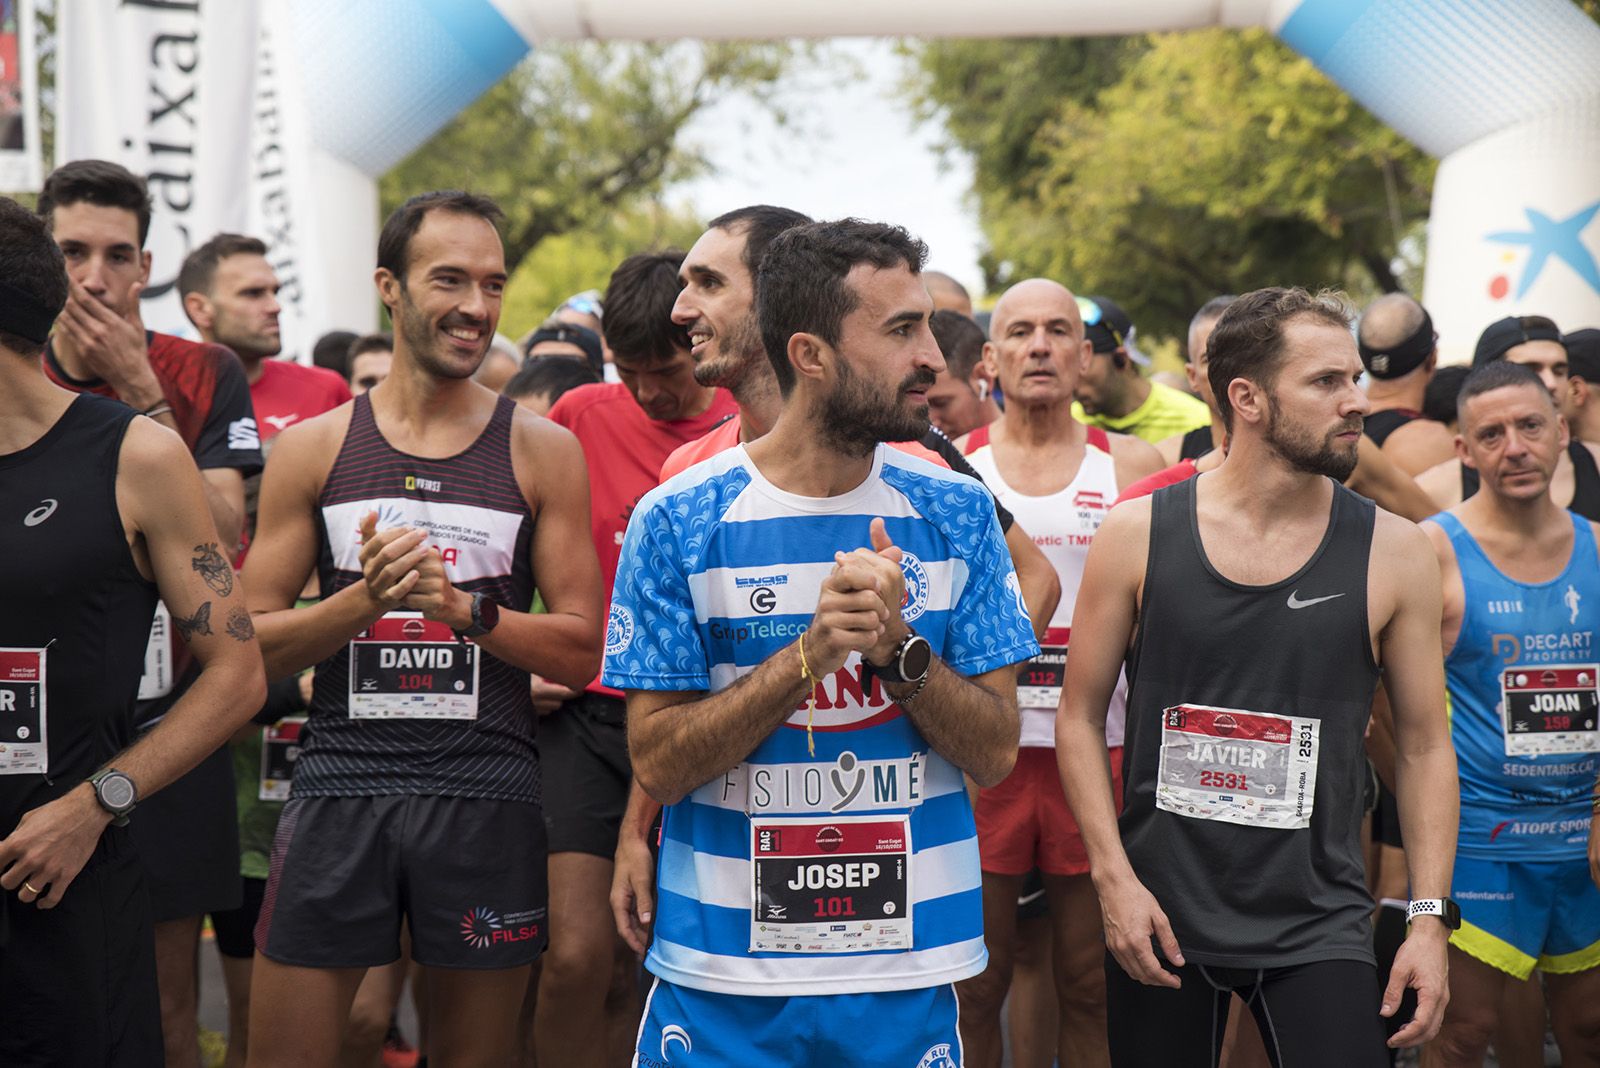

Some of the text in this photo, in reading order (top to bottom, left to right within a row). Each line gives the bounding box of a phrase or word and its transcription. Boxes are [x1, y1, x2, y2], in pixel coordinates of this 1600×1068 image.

[1524, 631, 1593, 650] DECART
[380, 647, 454, 669] DAVID
[1525, 650, 1592, 662] PROPERTY
[398, 673, 433, 690] 104
[1029, 671, 1056, 685] 112
[1529, 693, 1581, 713] JOAN
[1299, 723, 1313, 758] 2531
[1186, 742, 1268, 770] JAVIER
[1199, 769, 1249, 792] 2531
[1510, 821, 1559, 834] ATOPE
[760, 831, 771, 851] RAC
[788, 863, 881, 891] JOSEP
[814, 896, 857, 918] 101
[492, 924, 538, 945] FILSA
